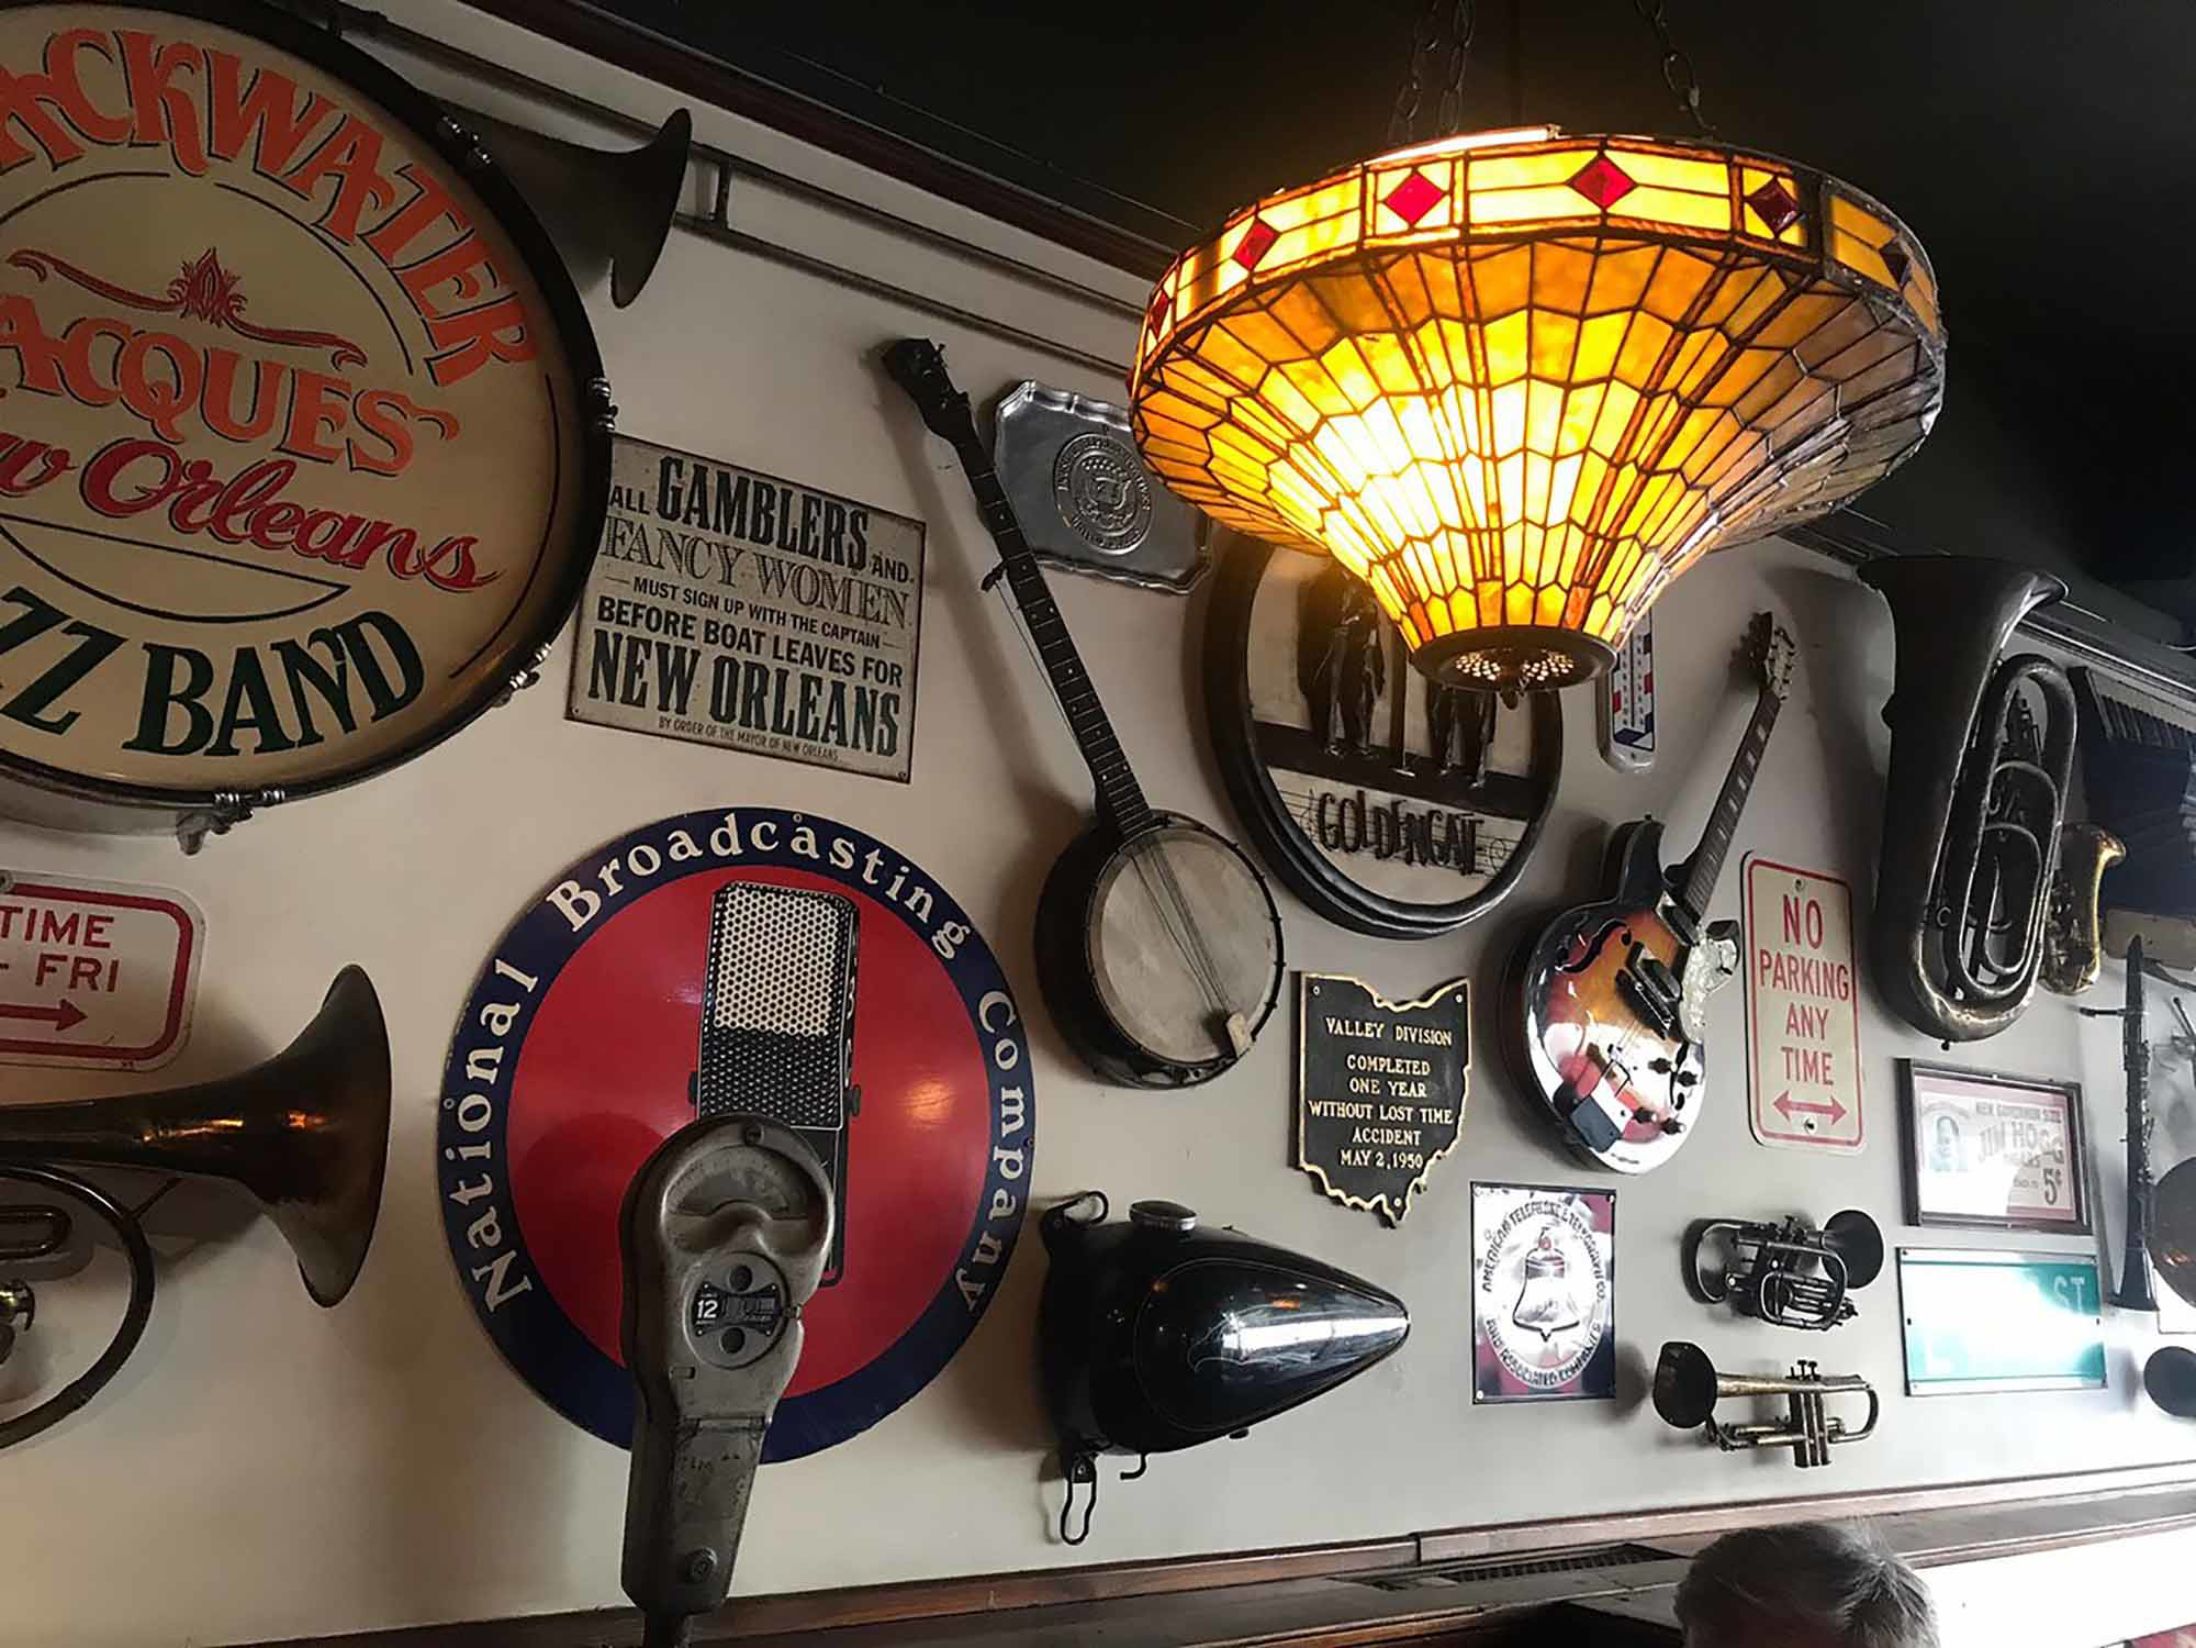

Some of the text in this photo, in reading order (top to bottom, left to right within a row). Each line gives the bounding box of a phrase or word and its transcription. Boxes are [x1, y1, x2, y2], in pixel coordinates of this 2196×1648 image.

[80, 438, 504, 592] Orleans
[609, 456, 908, 583] ALL GAMBLERS AND
[601, 515, 910, 629] FANCY WOMEN
[633, 577, 880, 649] MUST SIGN UP WITH THE CAPTAIN
[598, 596, 903, 688] BEFORE BOAT LEAVES FOR
[121, 611, 424, 756] BAND
[588, 628, 900, 757] NEW ORLEANS
[659, 716, 671, 729] BY
[673, 718, 702, 735] ORDER
[706, 724, 717, 737] OF
[720, 727, 734, 741] THE
[738, 730, 767, 747] MAYOR
[769, 736, 780, 749] OF
[782, 738, 800, 753] NEW
[0, 906, 115, 949] TIME
[1783, 894, 1823, 950] NO
[35, 953, 120, 993] FRI
[1760, 950, 1849, 1001] PARKING
[1325, 1017, 1453, 1046] VALLEY DIVISION
[1786, 1003, 1830, 1040] ANY
[446, 812, 1024, 1313] National Broadcasting Company
[1347, 1054, 1431, 1076] COMPLETED
[1781, 1047, 1834, 1086] TIME
[1350, 1078, 1427, 1098] ONE YEAR
[1308, 1100, 1453, 1125] WITHOUT LOST TIME
[1352, 1127, 1422, 1146] ACCIDENT
[1341, 1150, 1370, 1168] MAY
[697, 1300, 718, 1318] 12
